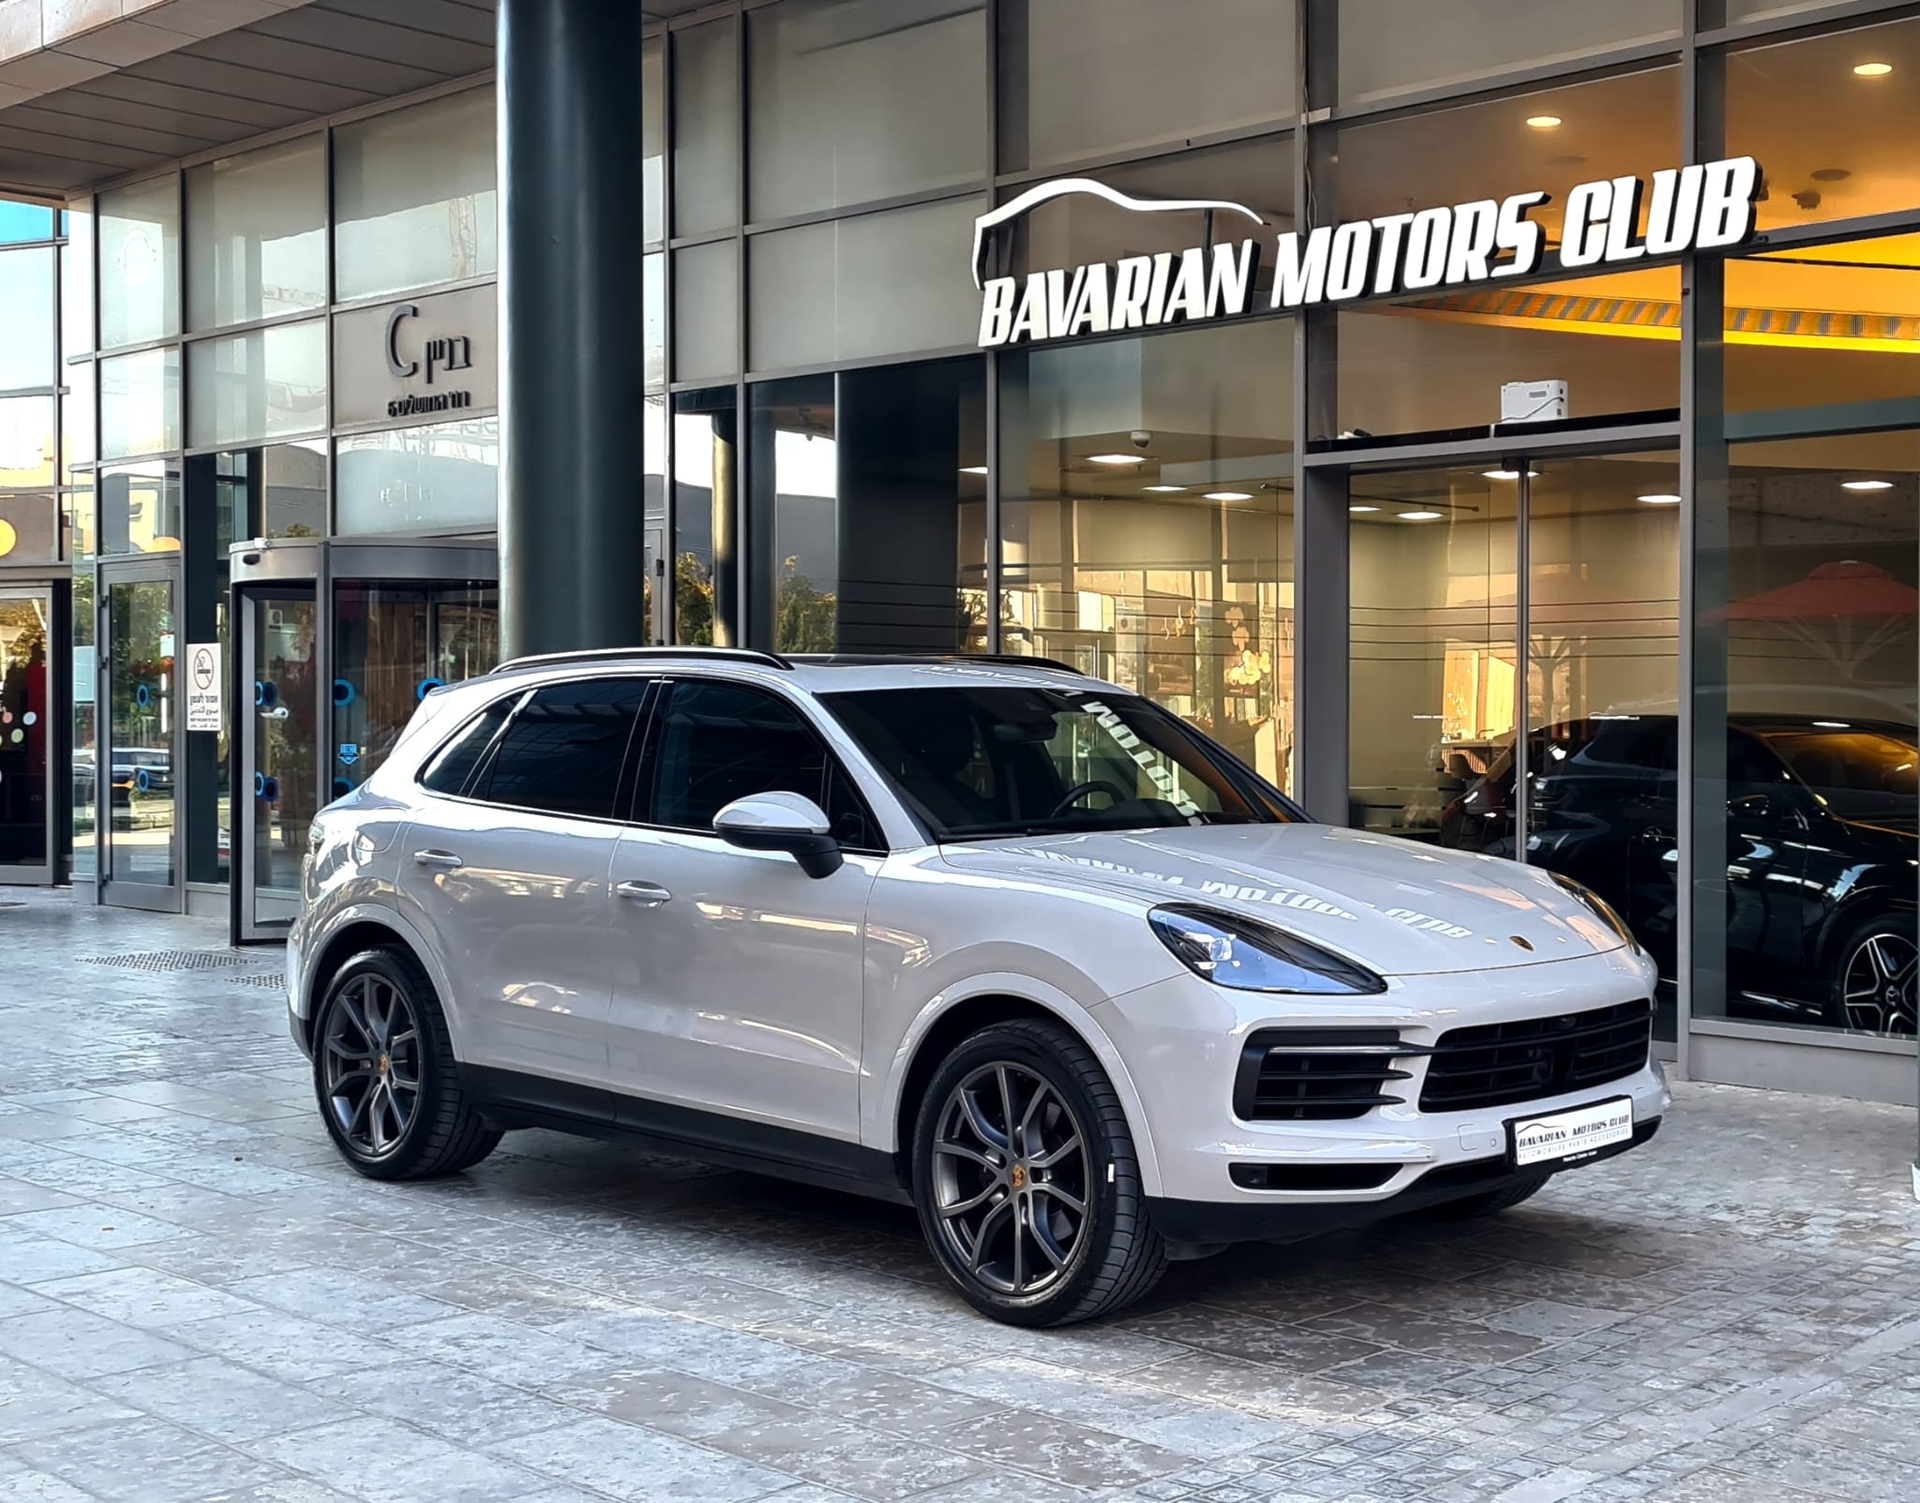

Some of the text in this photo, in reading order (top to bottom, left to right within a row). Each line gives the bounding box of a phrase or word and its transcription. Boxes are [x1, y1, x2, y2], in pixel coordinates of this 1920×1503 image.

[978, 155, 1764, 350] BAVARIAN MOTORS CLUB
[385, 304, 472, 384] בניין C
[1519, 1114, 1630, 1148] BAVARIAN MOTORS CLUB
